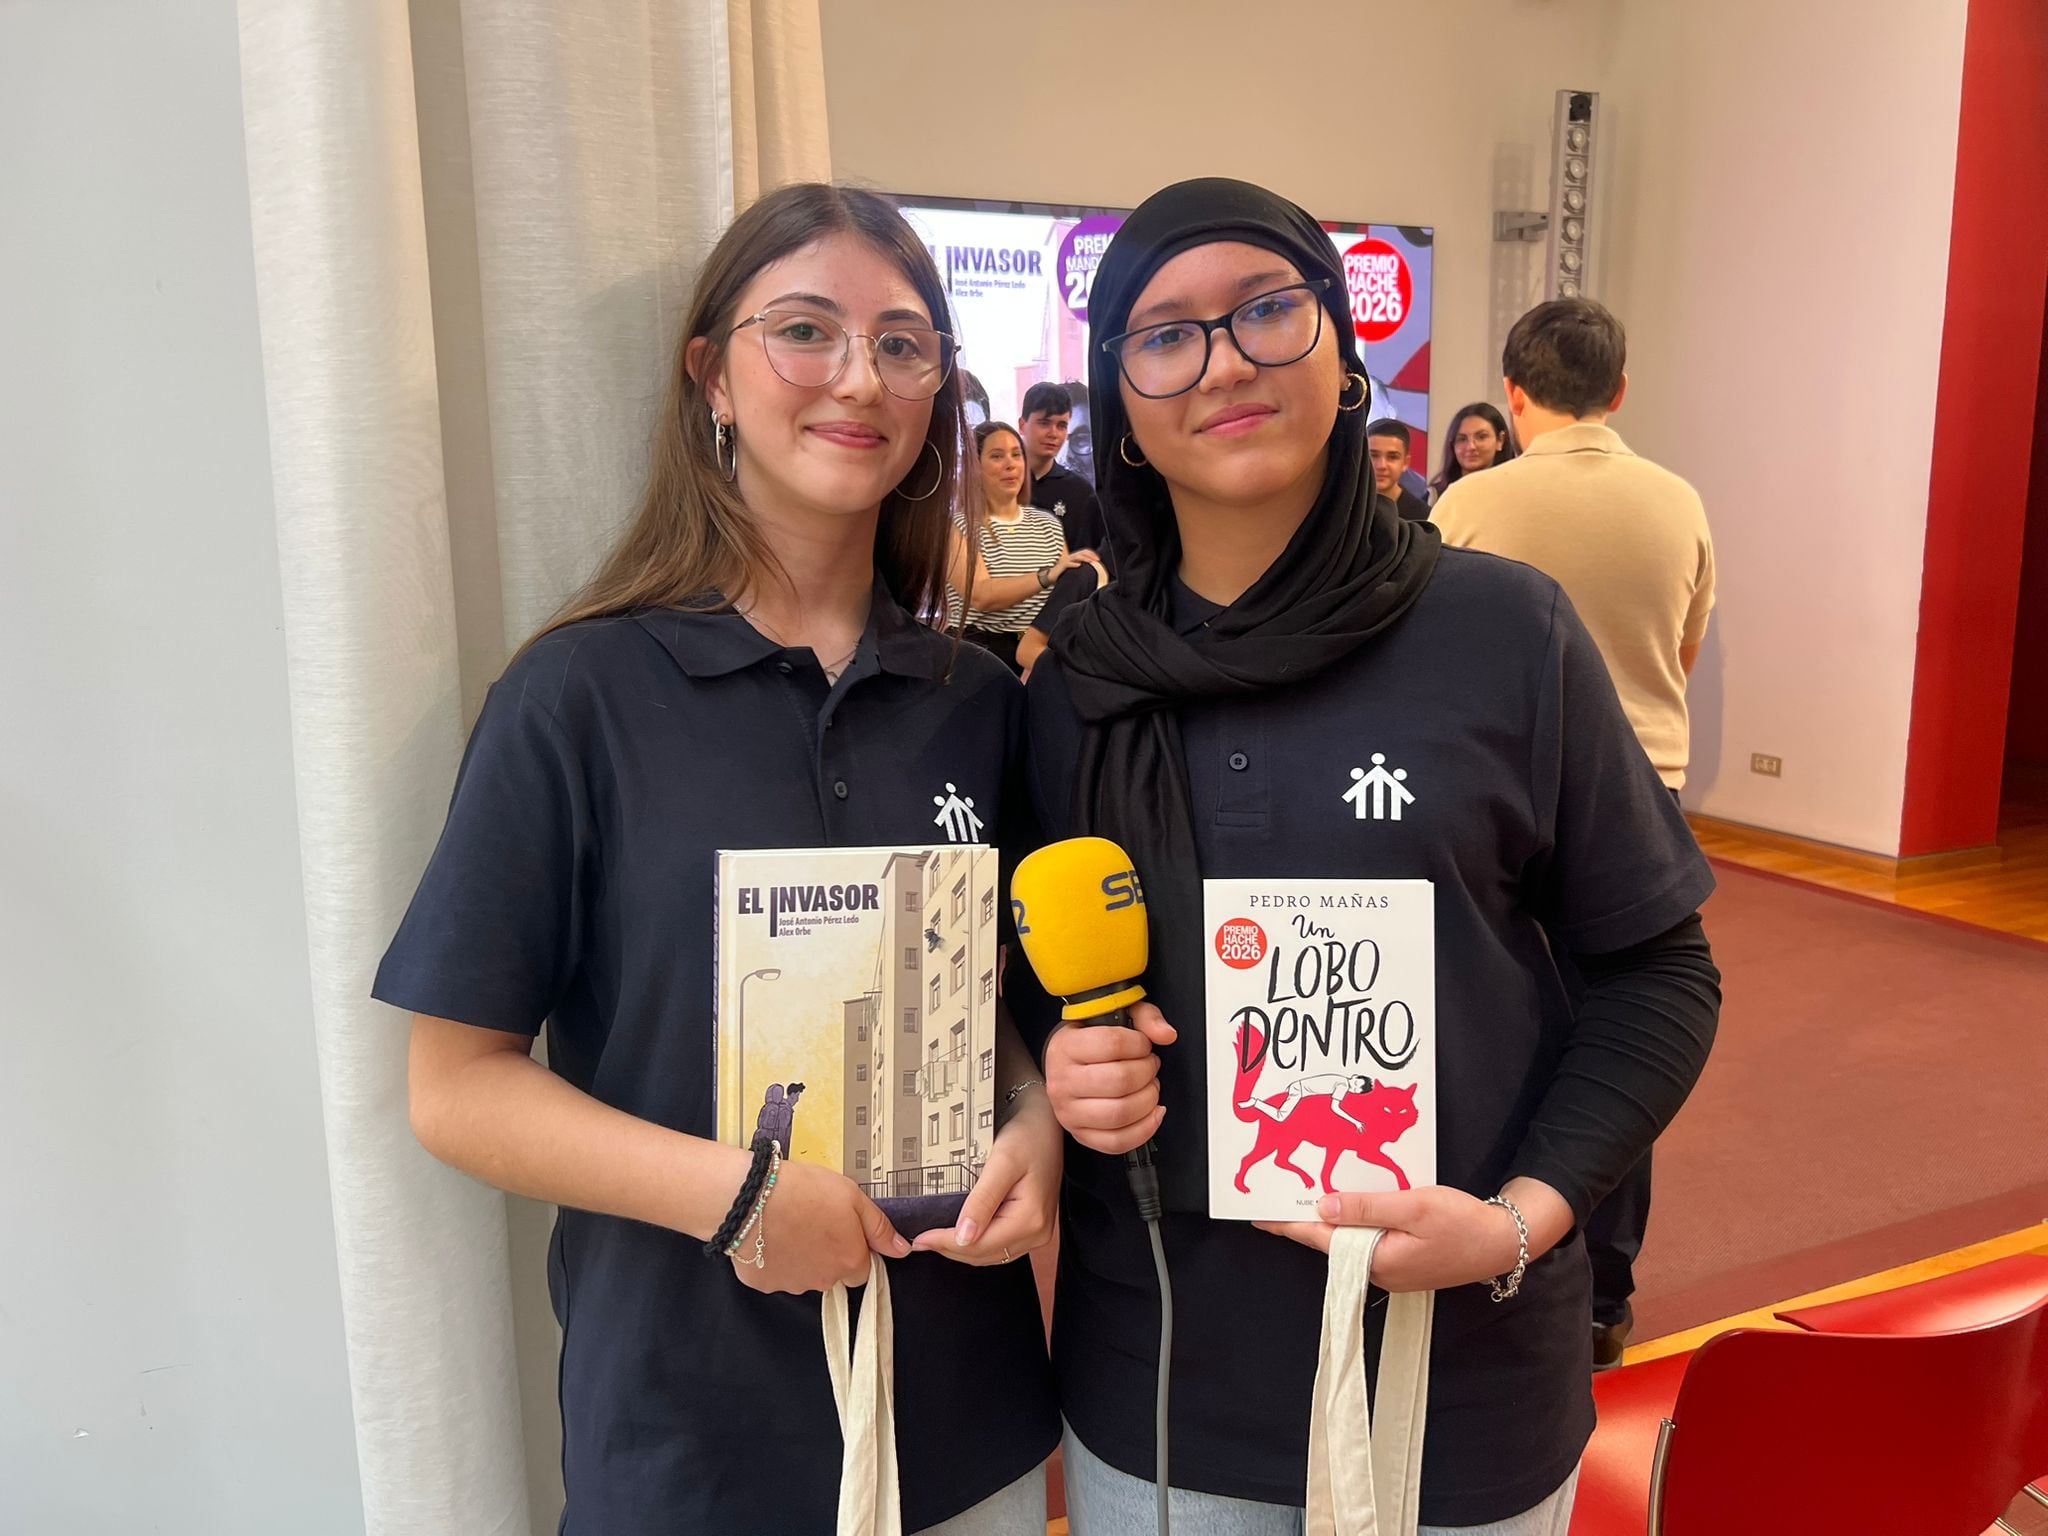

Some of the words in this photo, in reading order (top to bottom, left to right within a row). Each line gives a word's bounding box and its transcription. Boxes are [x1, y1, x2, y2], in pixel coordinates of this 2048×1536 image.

[945, 245, 1043, 294] INVASOR
[1065, 255, 1103, 272] MAND
[1344, 254, 1399, 273] PREMIO
[1345, 272, 1398, 292] HACHE
[1250, 895, 1311, 908] PEDRO
[1320, 893, 1389, 909] MAÑAS
[738, 887, 764, 914] EL
[770, 884, 879, 937] INVASOR
[779, 917, 794, 926] José
[795, 916, 822, 926] Antonio
[823, 915, 842, 925] Pérez
[843, 914, 860, 924] Ledo
[1291, 914, 1335, 939] Un
[779, 928, 794, 937] Alex
[795, 927, 811, 936] Orbe
[1223, 925, 1259, 935] PREMIO
[1223, 934, 1258, 945] HACHE
[1221, 944, 1261, 960] 2026
[1267, 939, 1380, 1004] LOBO
